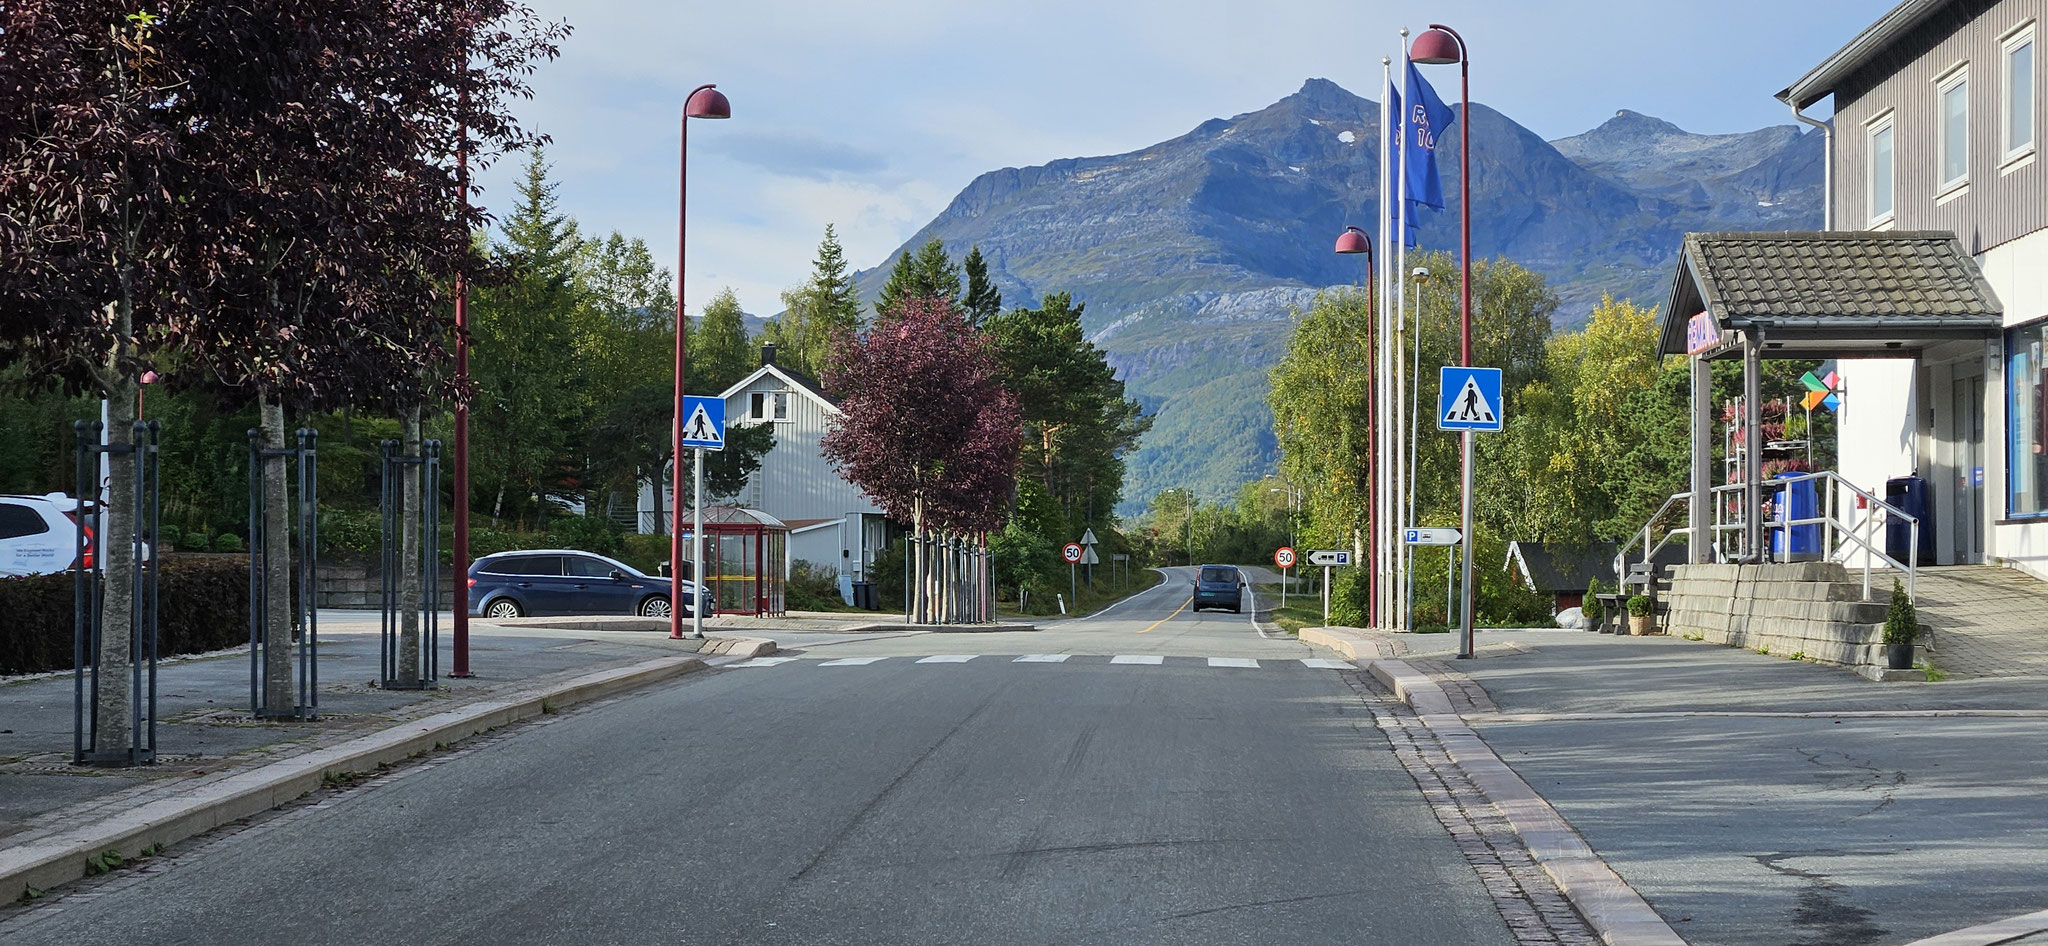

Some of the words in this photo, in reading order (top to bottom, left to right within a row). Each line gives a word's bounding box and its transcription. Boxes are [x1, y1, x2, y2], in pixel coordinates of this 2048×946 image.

[1409, 532, 1415, 540] P
[1066, 548, 1079, 558] 50
[1279, 553, 1292, 562] 50
